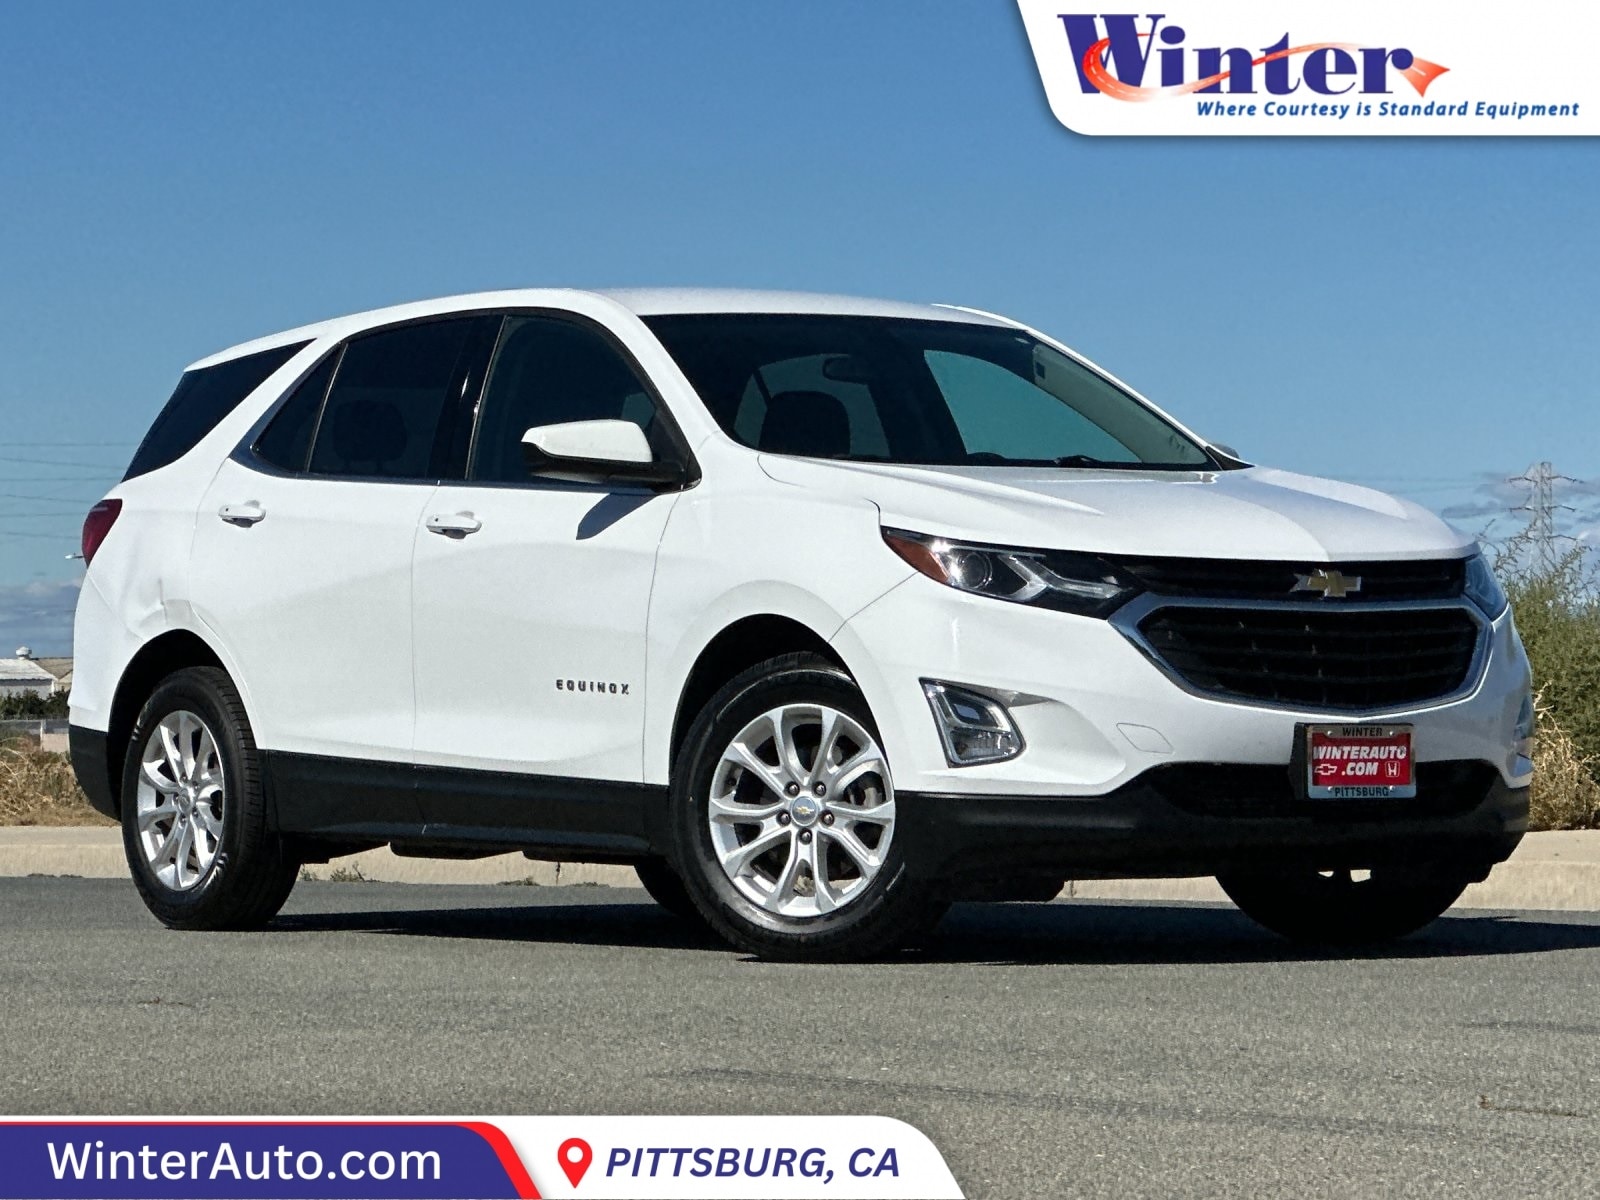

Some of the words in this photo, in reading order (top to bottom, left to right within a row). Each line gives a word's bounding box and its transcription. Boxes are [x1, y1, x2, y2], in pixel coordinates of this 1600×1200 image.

[556, 679, 629, 695] EQUINOX
[1342, 727, 1383, 737] WINTER
[1312, 745, 1407, 760] WINTERAUTO
[1341, 761, 1379, 776] .COM
[1334, 786, 1390, 797] PITTSBURG
